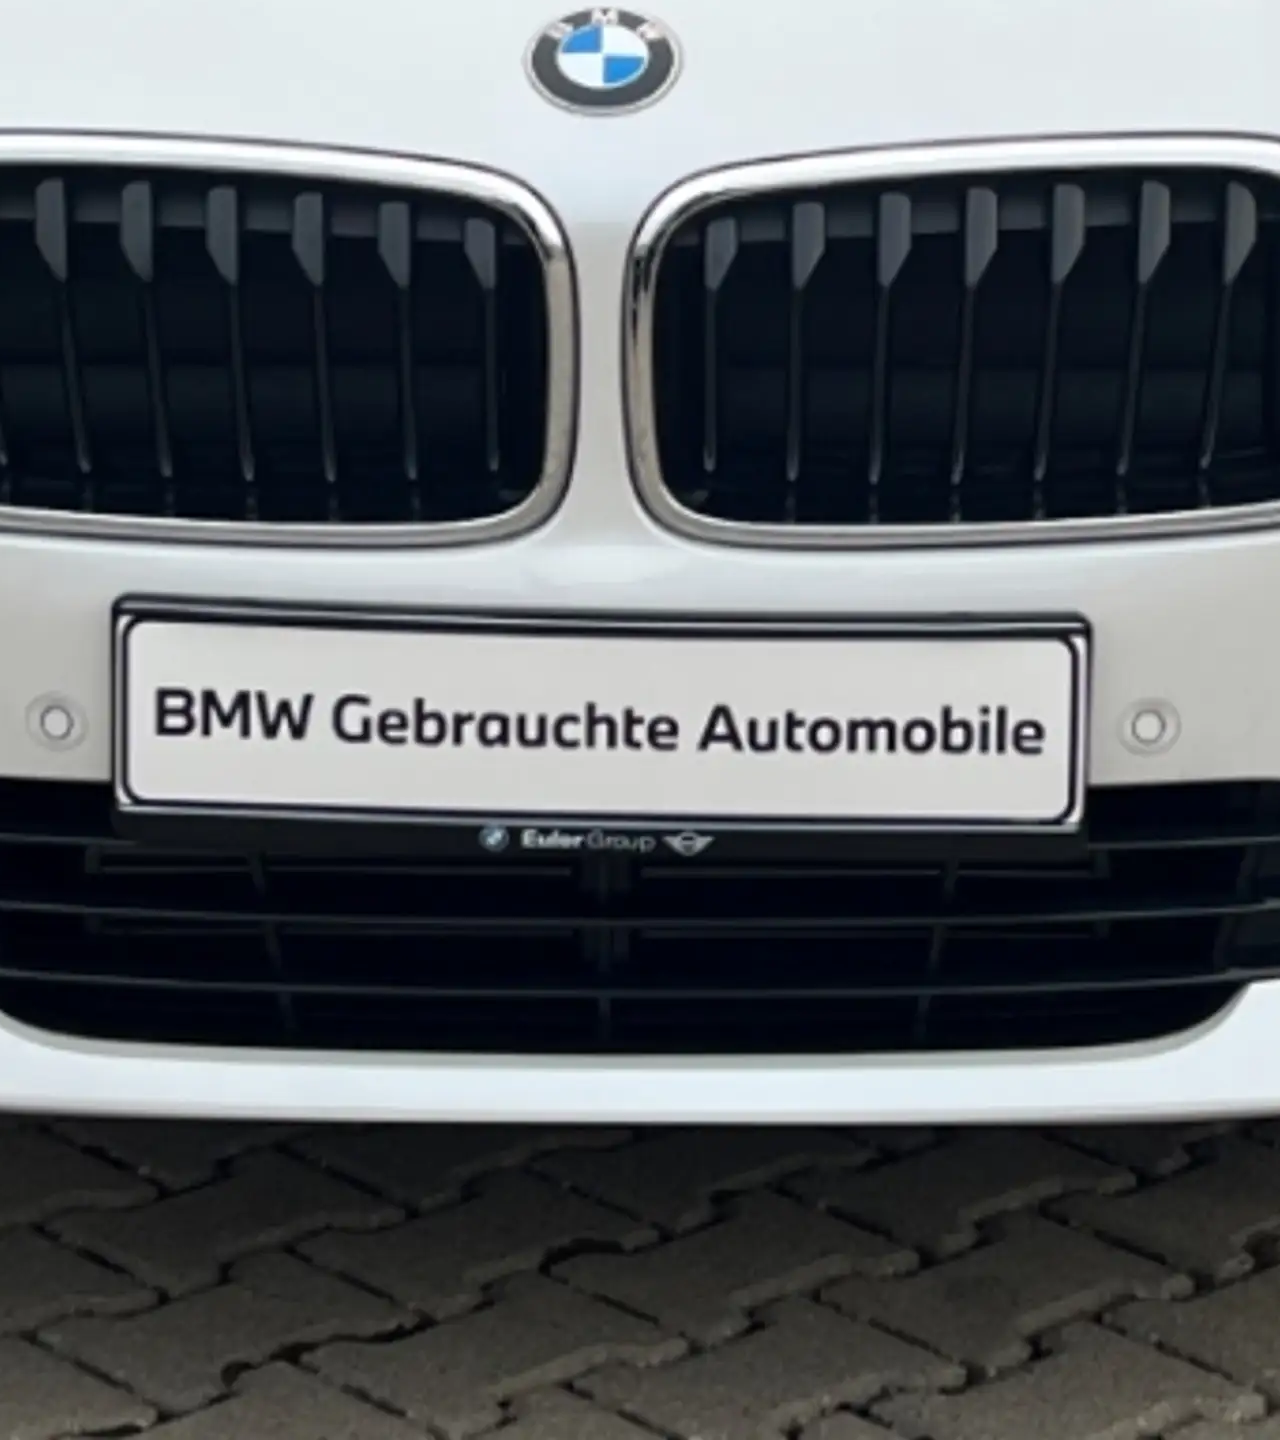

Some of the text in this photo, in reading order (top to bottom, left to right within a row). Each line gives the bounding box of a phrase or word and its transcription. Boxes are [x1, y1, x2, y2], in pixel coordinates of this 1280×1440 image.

[154, 687, 1046, 755] BMW Gebrauchte Automobile
